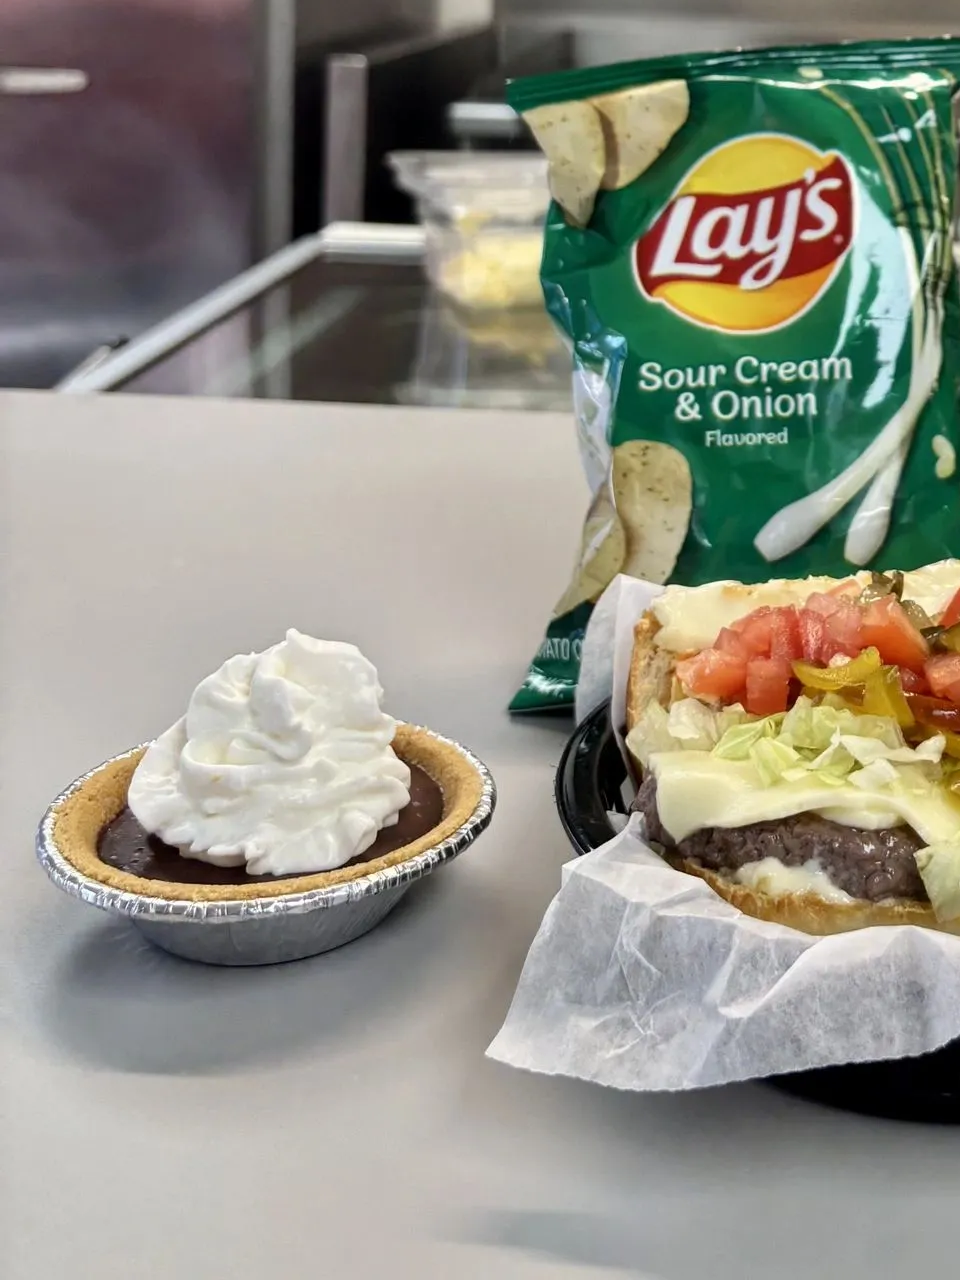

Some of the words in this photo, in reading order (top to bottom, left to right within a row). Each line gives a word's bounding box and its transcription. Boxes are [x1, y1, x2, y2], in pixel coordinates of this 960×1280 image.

[648, 168, 841, 292] Lay's
[638, 361, 727, 392] Sour
[734, 355, 853, 384] Cream
[674, 391, 703, 421] &
[711, 387, 818, 421] Onion
[704, 426, 789, 448] Flavored
